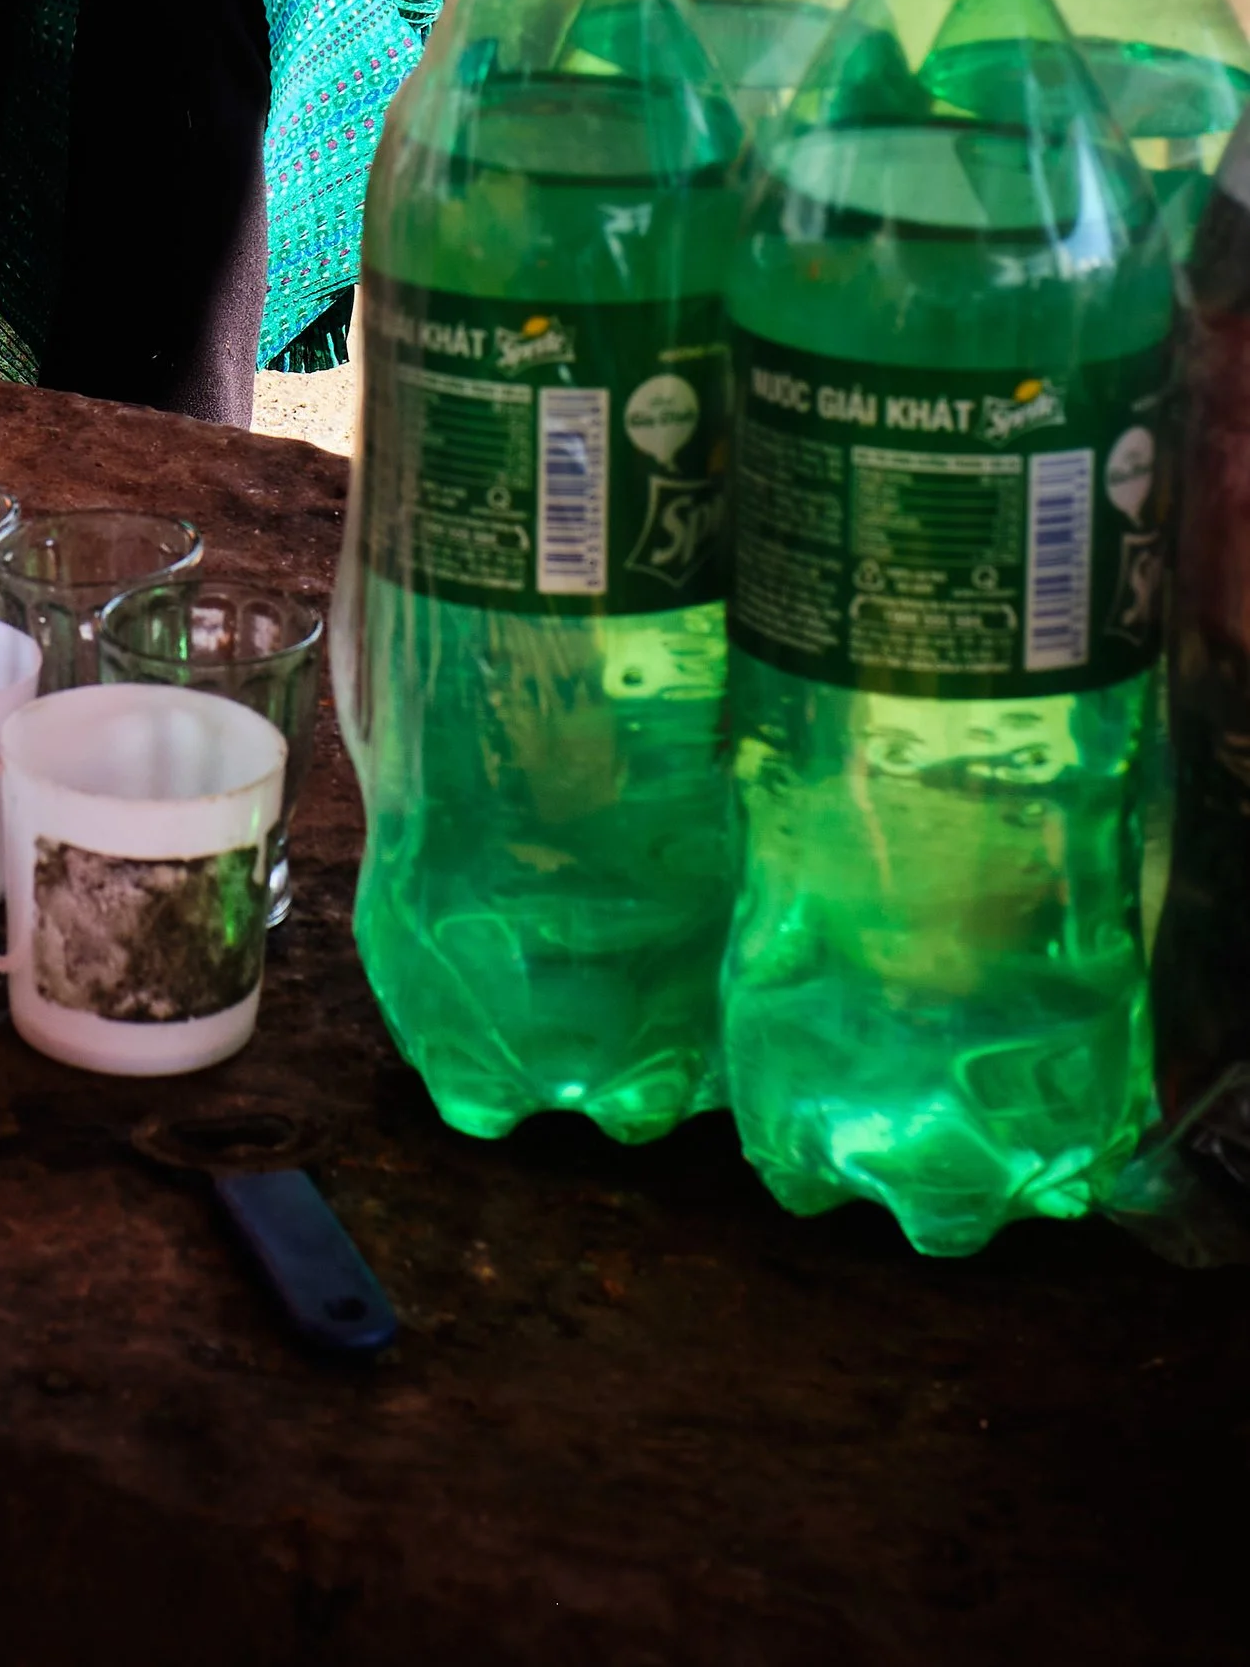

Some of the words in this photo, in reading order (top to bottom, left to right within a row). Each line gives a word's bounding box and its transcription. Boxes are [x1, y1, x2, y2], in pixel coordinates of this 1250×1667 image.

[419, 320, 488, 360] KHÁT
[817, 382, 878, 428] GIẢI
[886, 395, 977, 434] KHÁT
